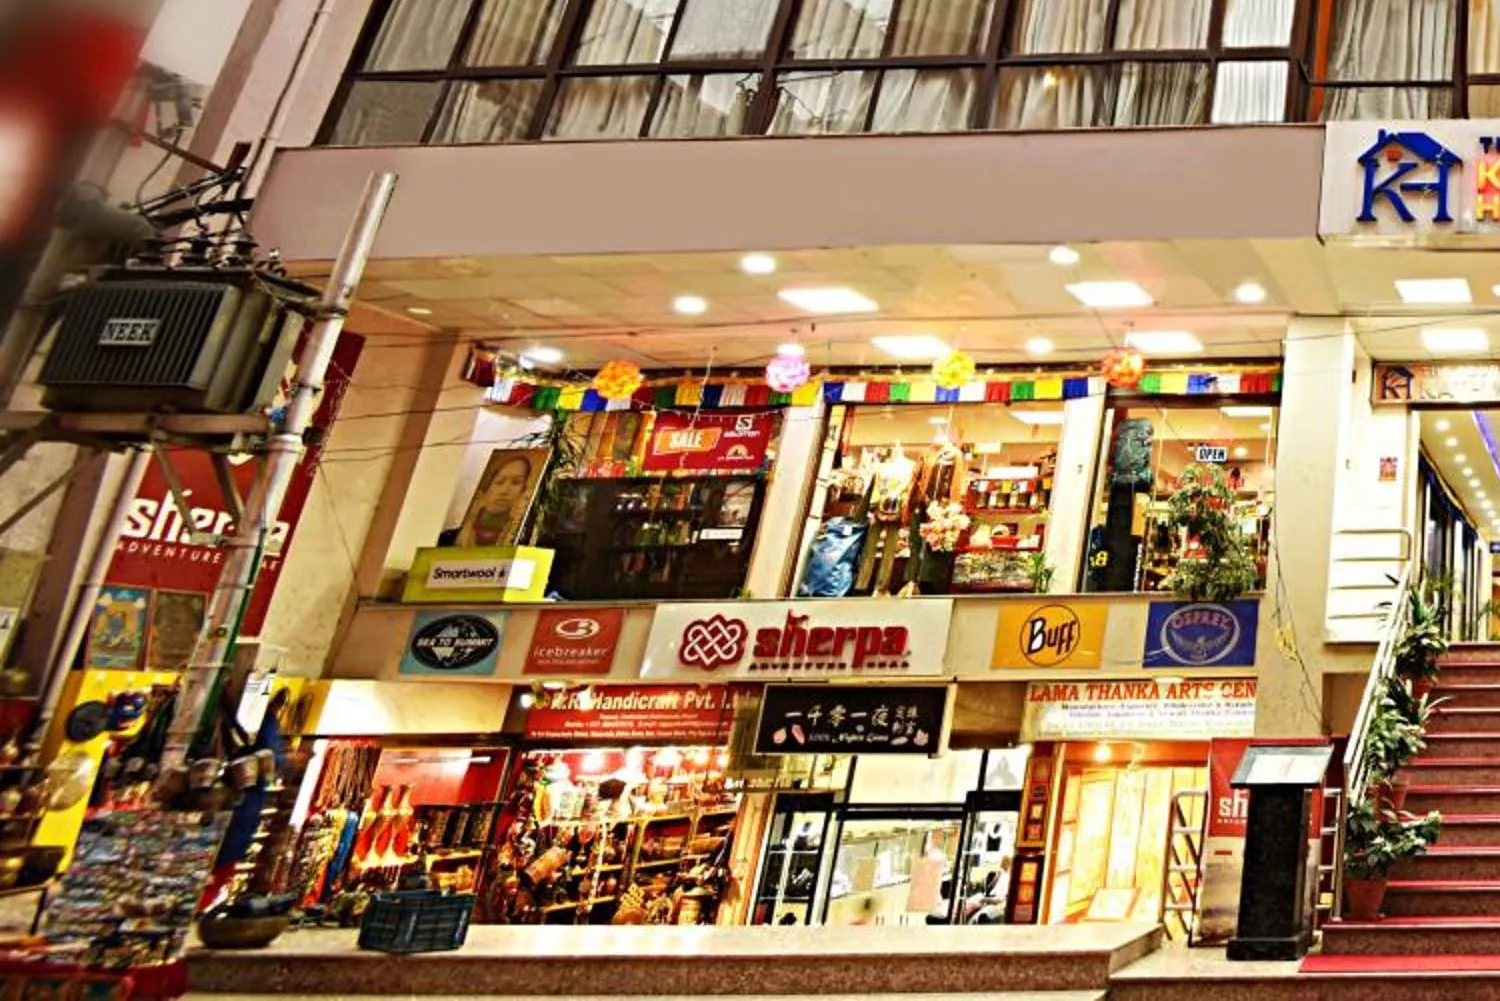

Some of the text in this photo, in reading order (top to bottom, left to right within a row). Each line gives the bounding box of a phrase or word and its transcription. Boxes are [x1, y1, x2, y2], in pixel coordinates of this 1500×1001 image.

[1199, 448, 1225, 460] OPEN
[116, 541, 226, 565] ADVENTURE
[433, 566, 497, 581] Smartwool
[1171, 610, 1234, 628] OSPREY
[752, 609, 909, 669] sherpa
[533, 645, 608, 658] icebreaker
[592, 690, 681, 710] Handicraft
[684, 690, 715, 710] Pvt.
[1031, 684, 1079, 703] LAMA
[1086, 682, 1160, 701] THANKA
[1166, 681, 1214, 700] ARTS
